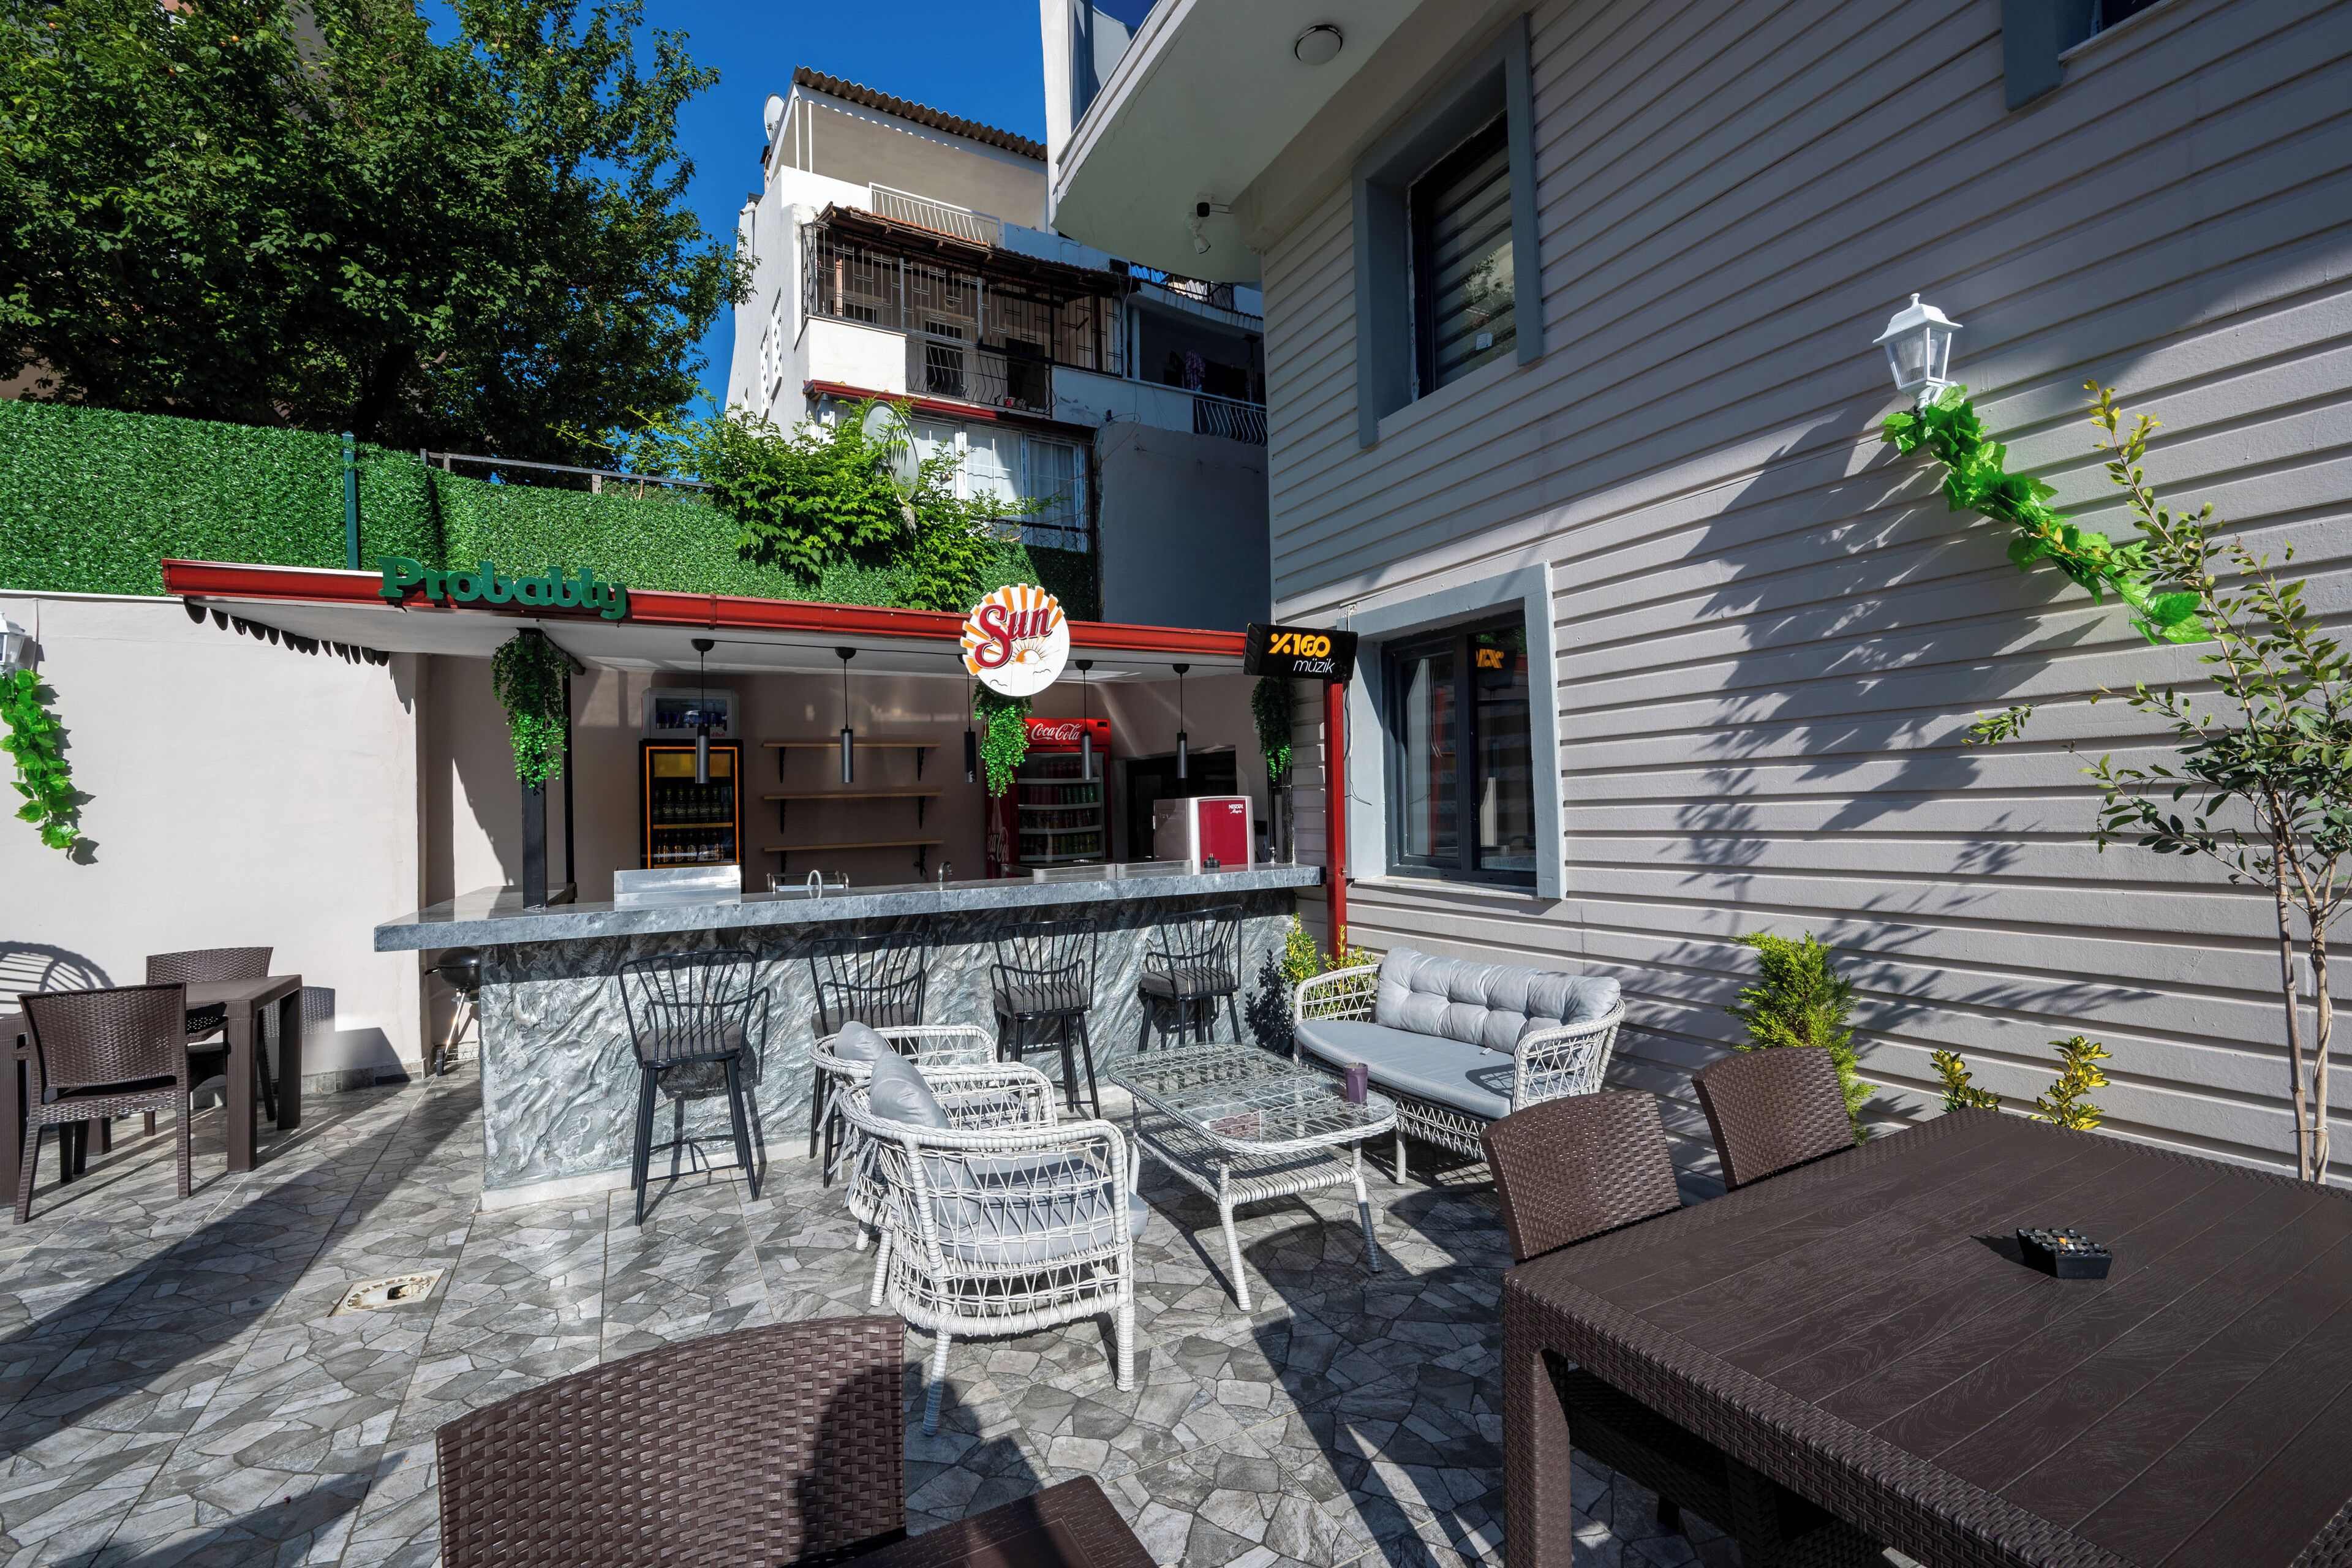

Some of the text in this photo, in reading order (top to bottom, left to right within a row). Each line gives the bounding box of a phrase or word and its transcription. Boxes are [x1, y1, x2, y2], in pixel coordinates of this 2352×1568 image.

[377, 556, 626, 620] Probably
[974, 604, 1053, 669] Sun
[1293, 658, 1335, 674] müzik
[1031, 723, 1082, 741] Coca-Cola
